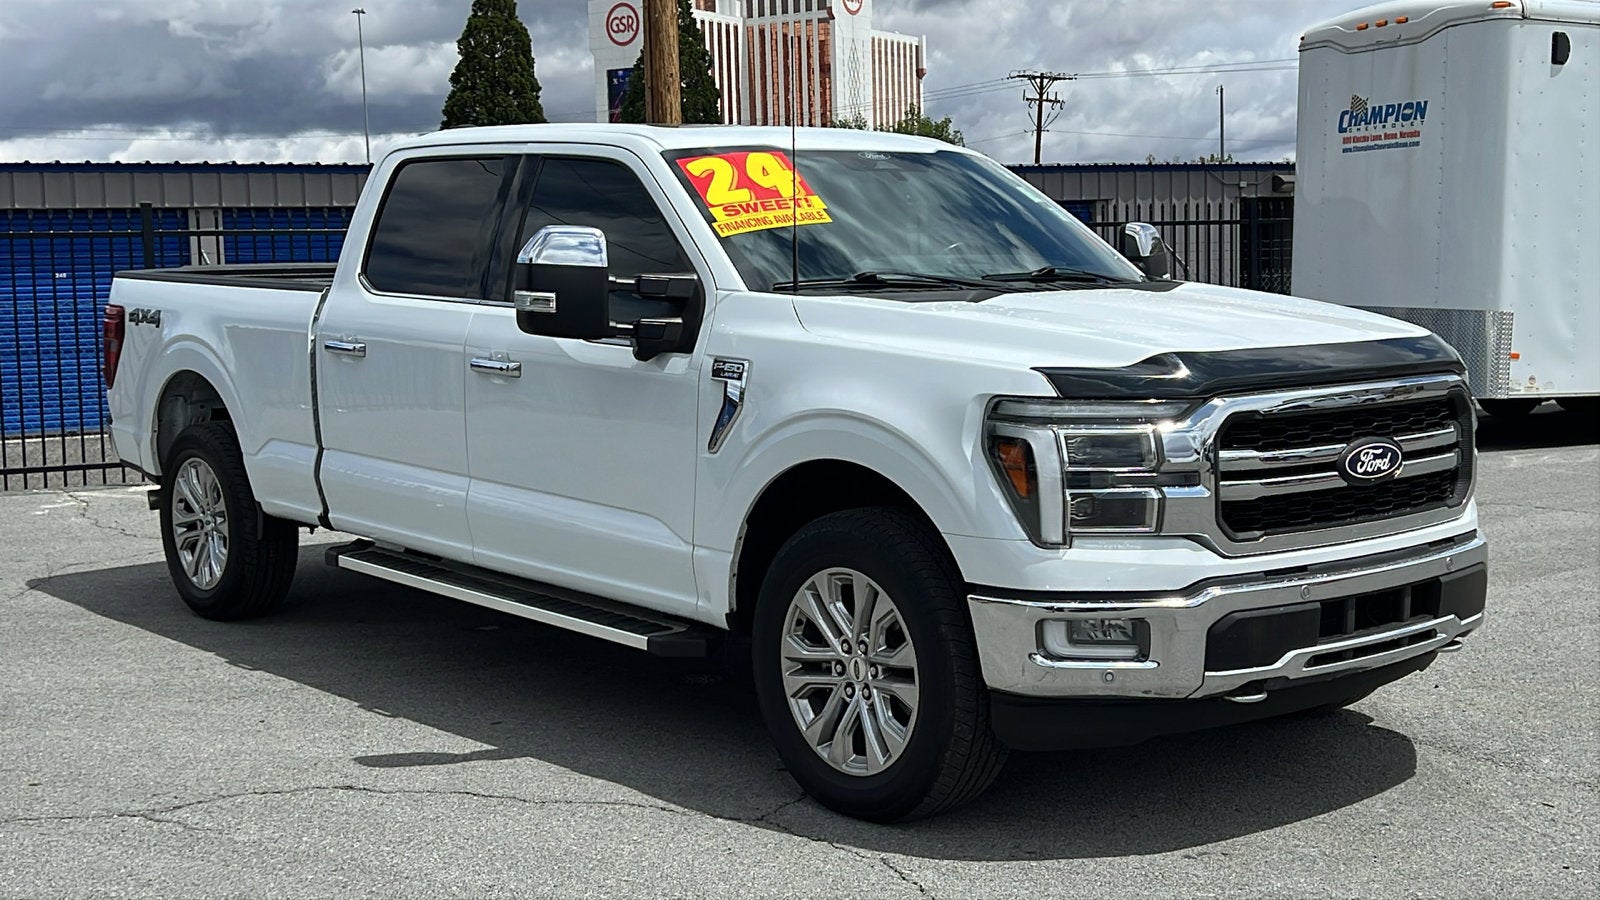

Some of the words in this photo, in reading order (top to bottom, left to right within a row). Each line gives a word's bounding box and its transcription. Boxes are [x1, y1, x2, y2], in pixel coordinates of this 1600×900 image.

[610, 15, 635, 34] GSR
[1338, 100, 1428, 133] CHAMPION
[1348, 120, 1425, 133] CHEVROLET
[685, 151, 804, 206] 24
[721, 197, 813, 217] SWEET!
[716, 215, 774, 234] FINANCING
[775, 210, 827, 224] AVAILABLE
[1356, 448, 1392, 473] Ford
